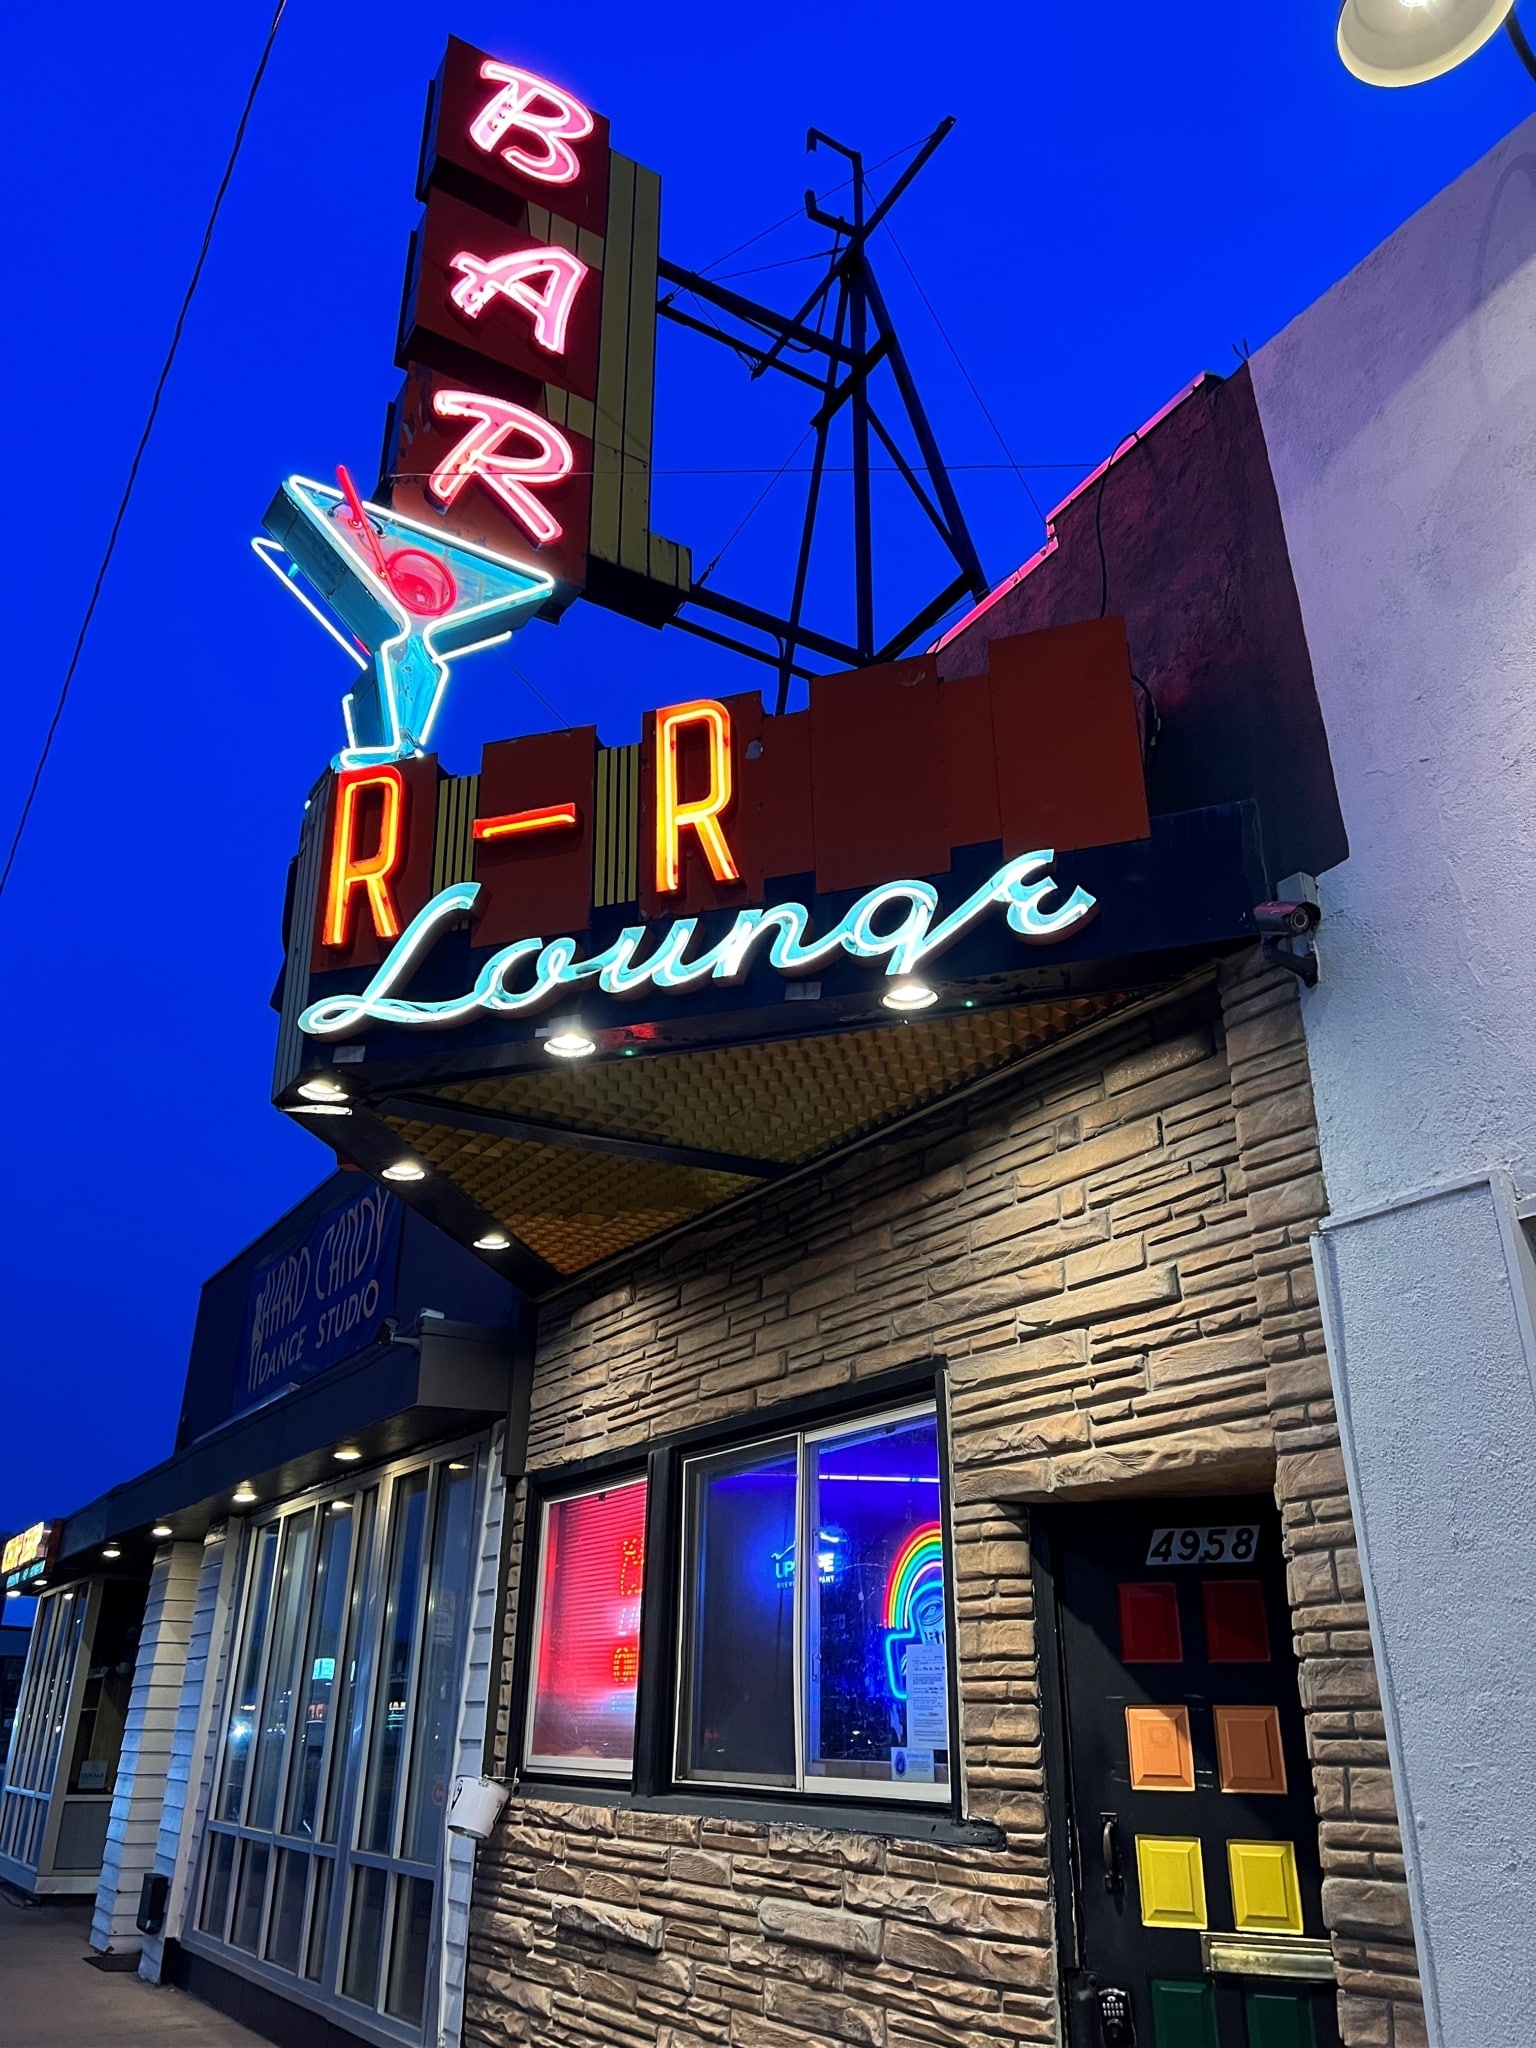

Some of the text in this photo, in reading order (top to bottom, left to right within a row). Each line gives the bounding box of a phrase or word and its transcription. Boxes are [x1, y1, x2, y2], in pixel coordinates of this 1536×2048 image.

[428, 59, 595, 545] BAR
[297, 848, 1097, 1035] Lounge
[258, 1279, 379, 1385] DANCE STUDIO
[261, 1186, 390, 1339] HARD CANDY
[1150, 1527, 1254, 1562] 4958
